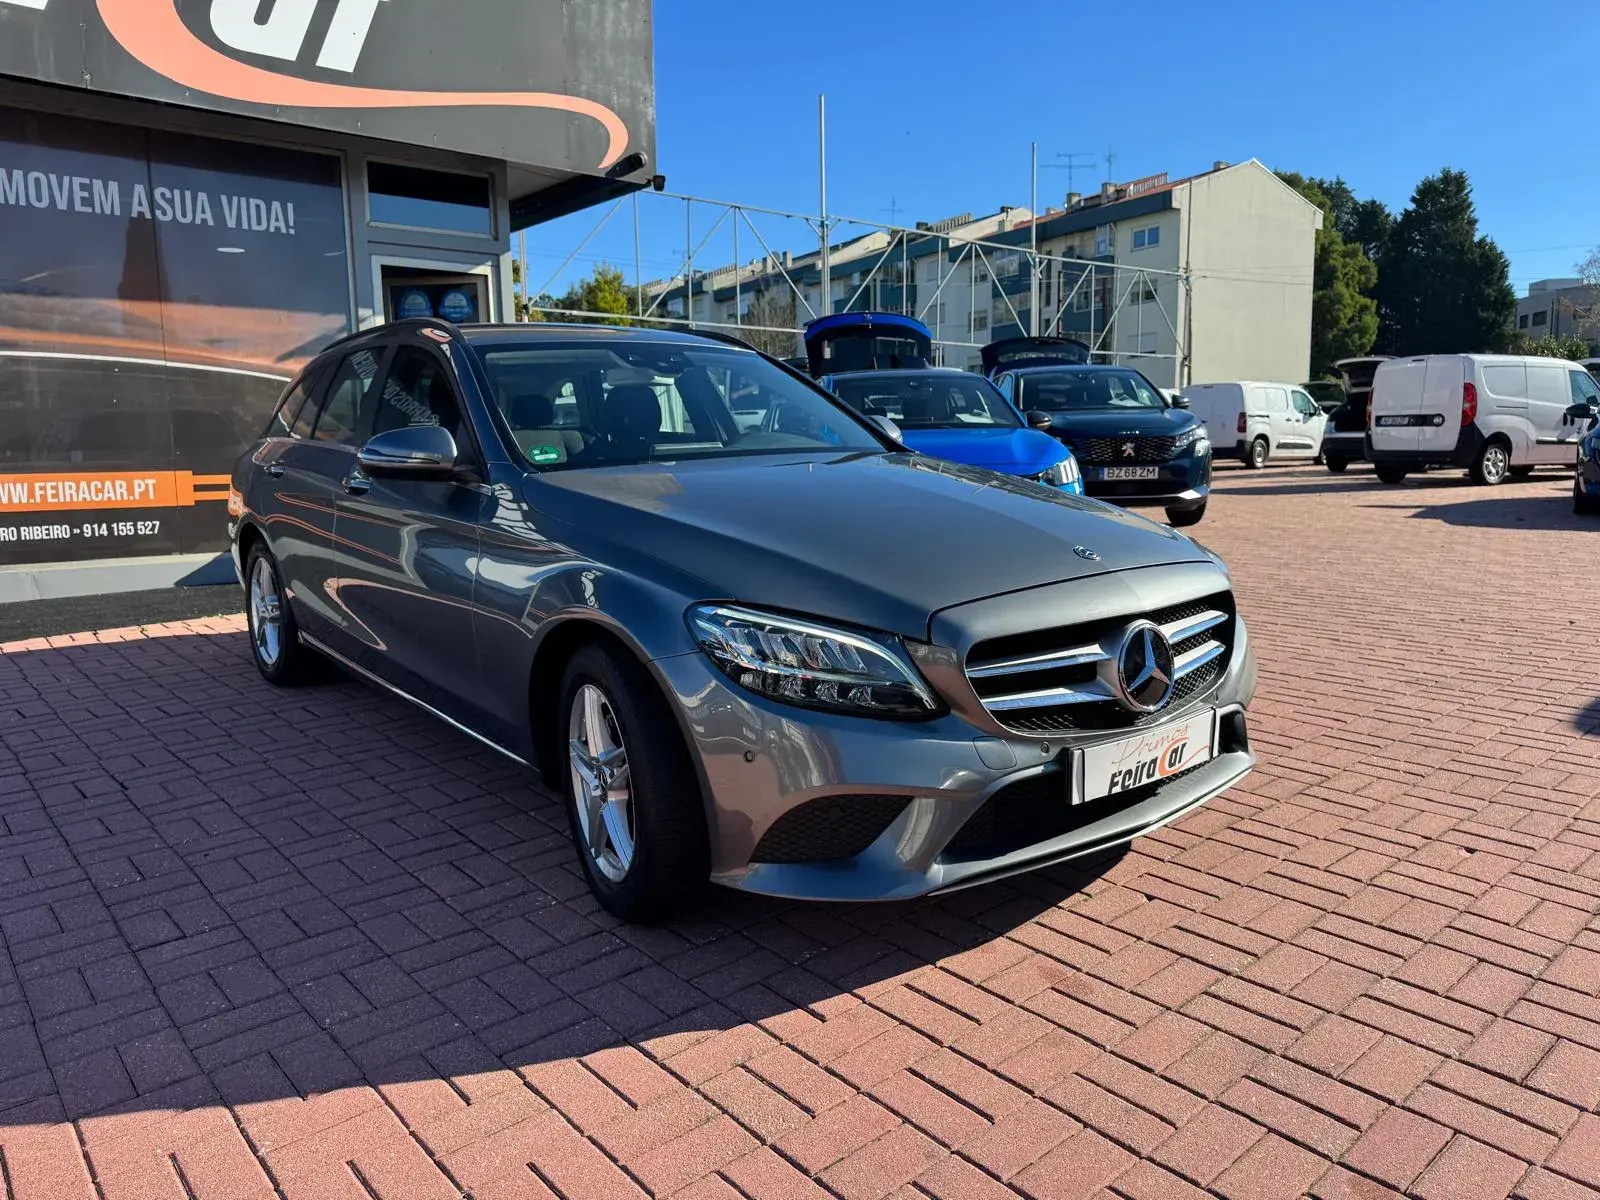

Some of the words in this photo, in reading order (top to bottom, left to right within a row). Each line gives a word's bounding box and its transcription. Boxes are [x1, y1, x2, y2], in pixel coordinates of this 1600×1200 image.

[0, 168, 120, 216] MOVEM
[153, 187, 214, 226] SUA
[220, 194, 295, 235] VIDA!
[20, 524, 71, 541] RIBEIRO
[83, 522, 109, 538] 914
[111, 521, 135, 536] 155
[137, 520, 161, 535] 527
